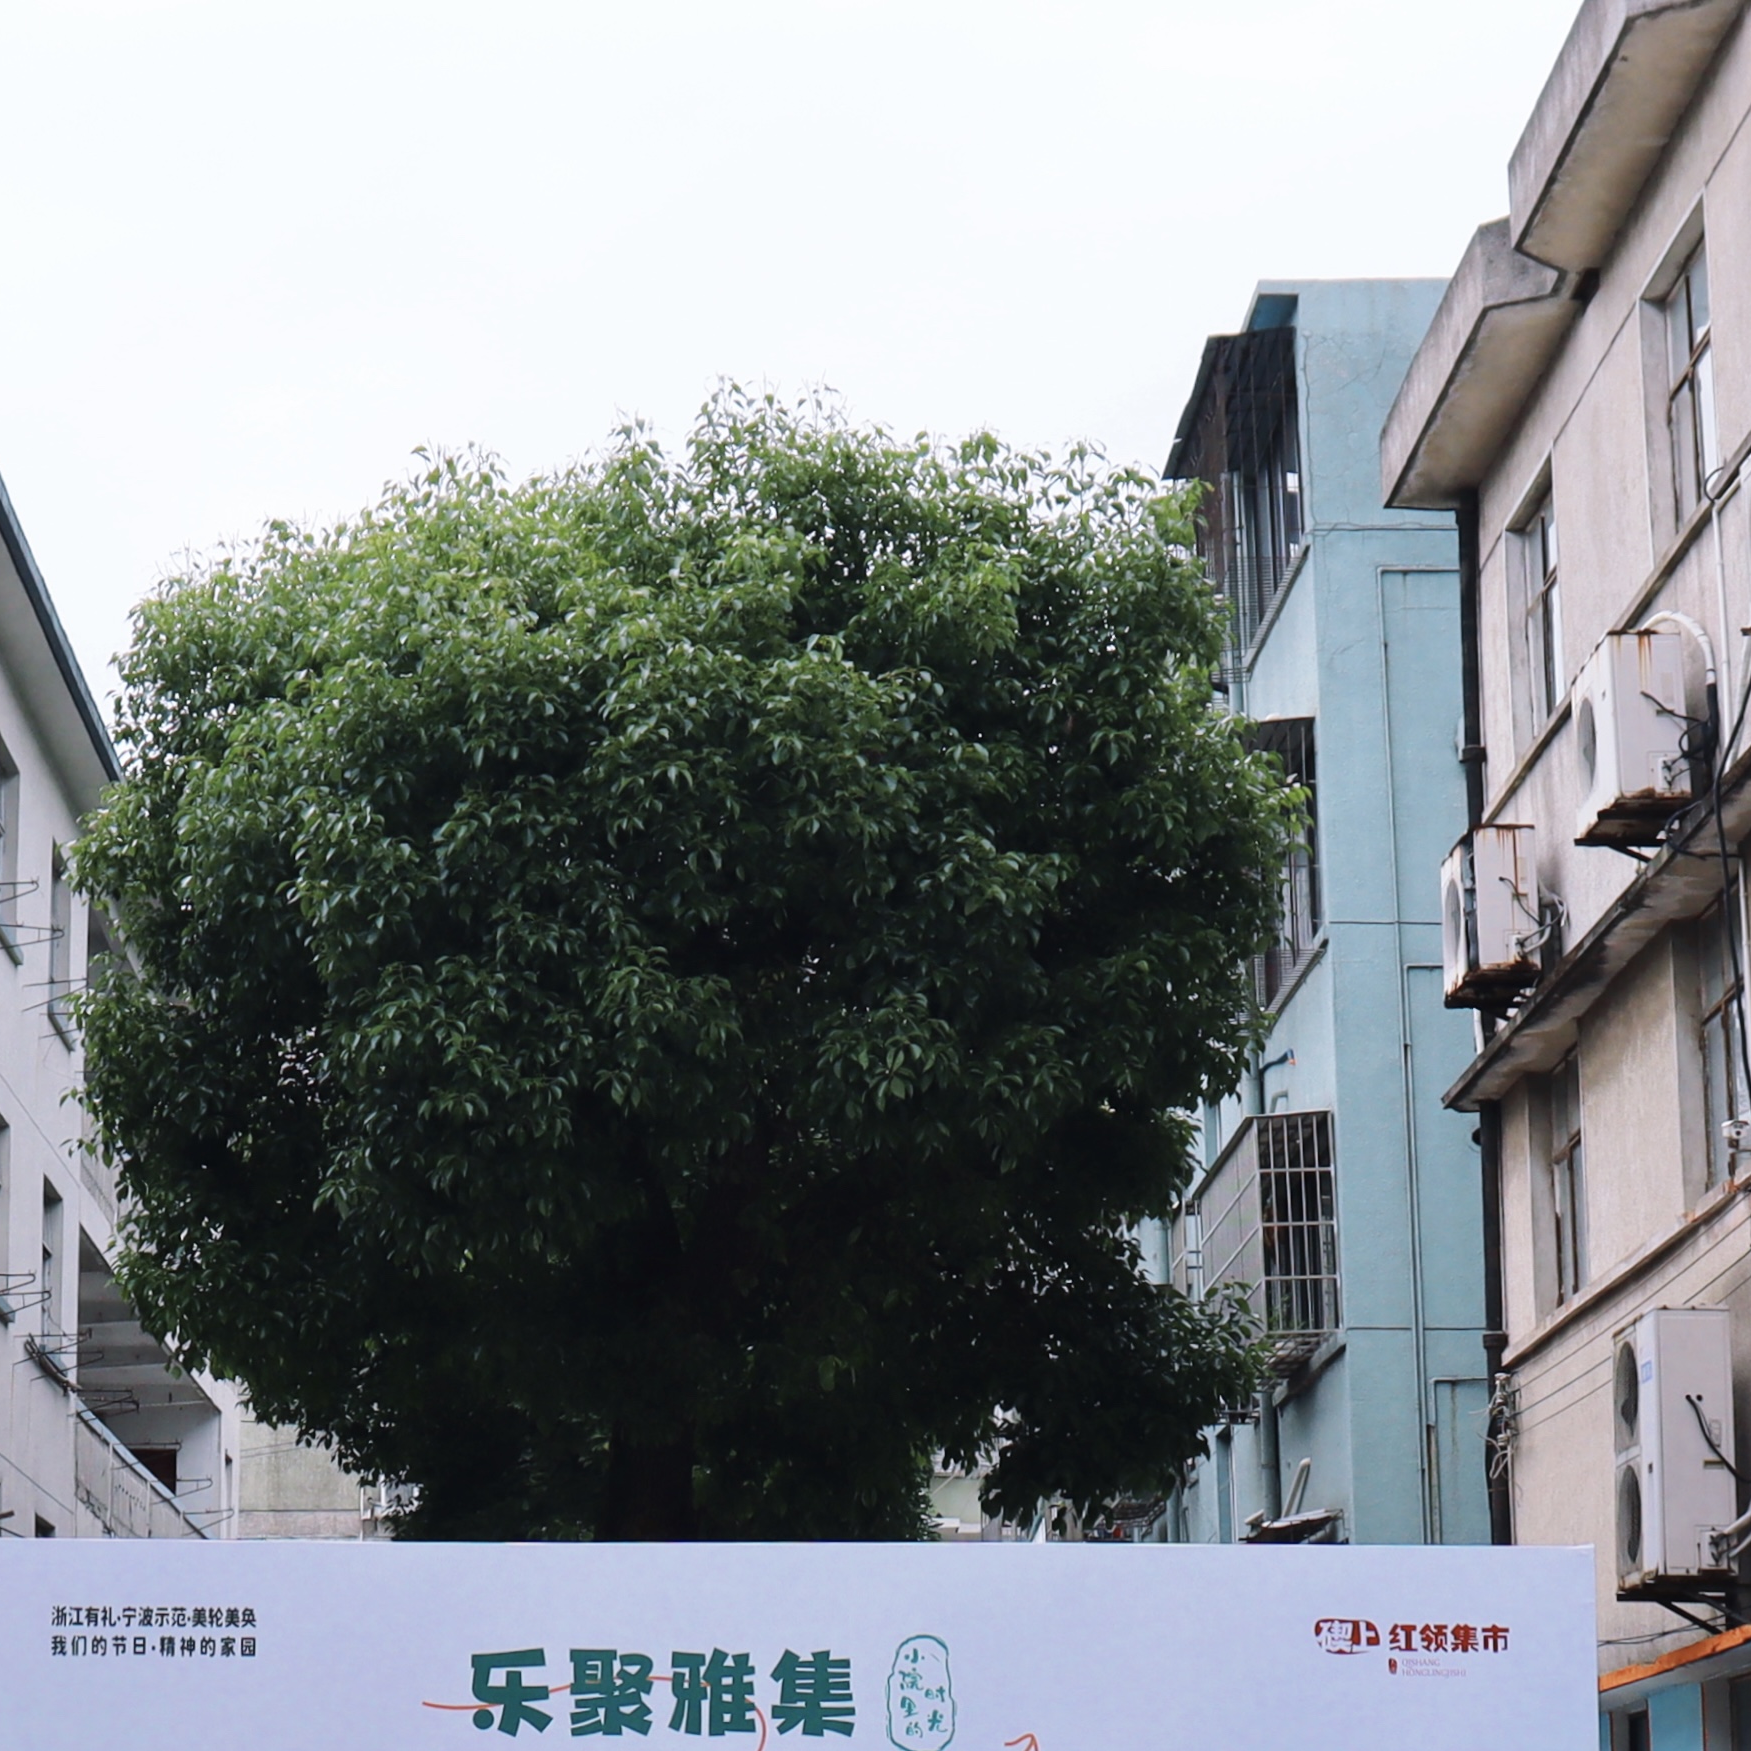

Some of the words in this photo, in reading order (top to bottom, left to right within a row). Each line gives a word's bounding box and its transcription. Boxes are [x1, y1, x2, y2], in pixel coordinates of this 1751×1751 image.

[1388, 1623, 1510, 1653] 红领集市
[470, 1647, 857, 1738] 乐聚雅集
